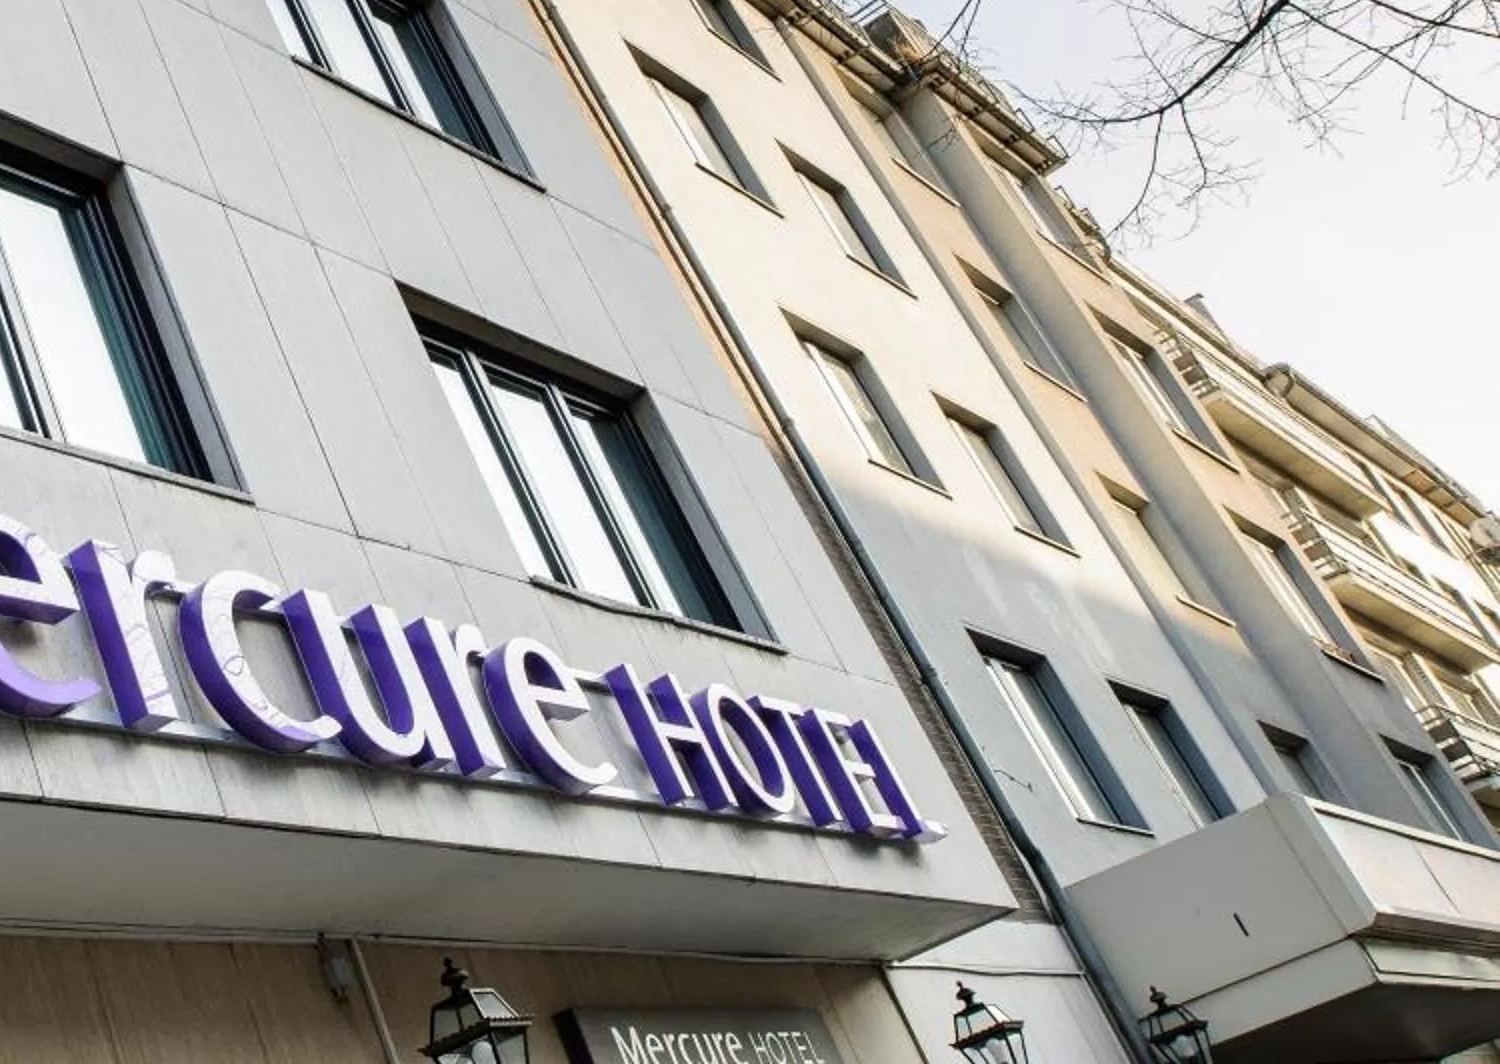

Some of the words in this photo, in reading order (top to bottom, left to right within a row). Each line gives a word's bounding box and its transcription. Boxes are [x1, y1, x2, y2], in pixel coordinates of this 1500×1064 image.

[604, 664, 949, 838] HOTEL
[611, 1025, 749, 1064] Mercure
[748, 1031, 825, 1064] HOTEL
